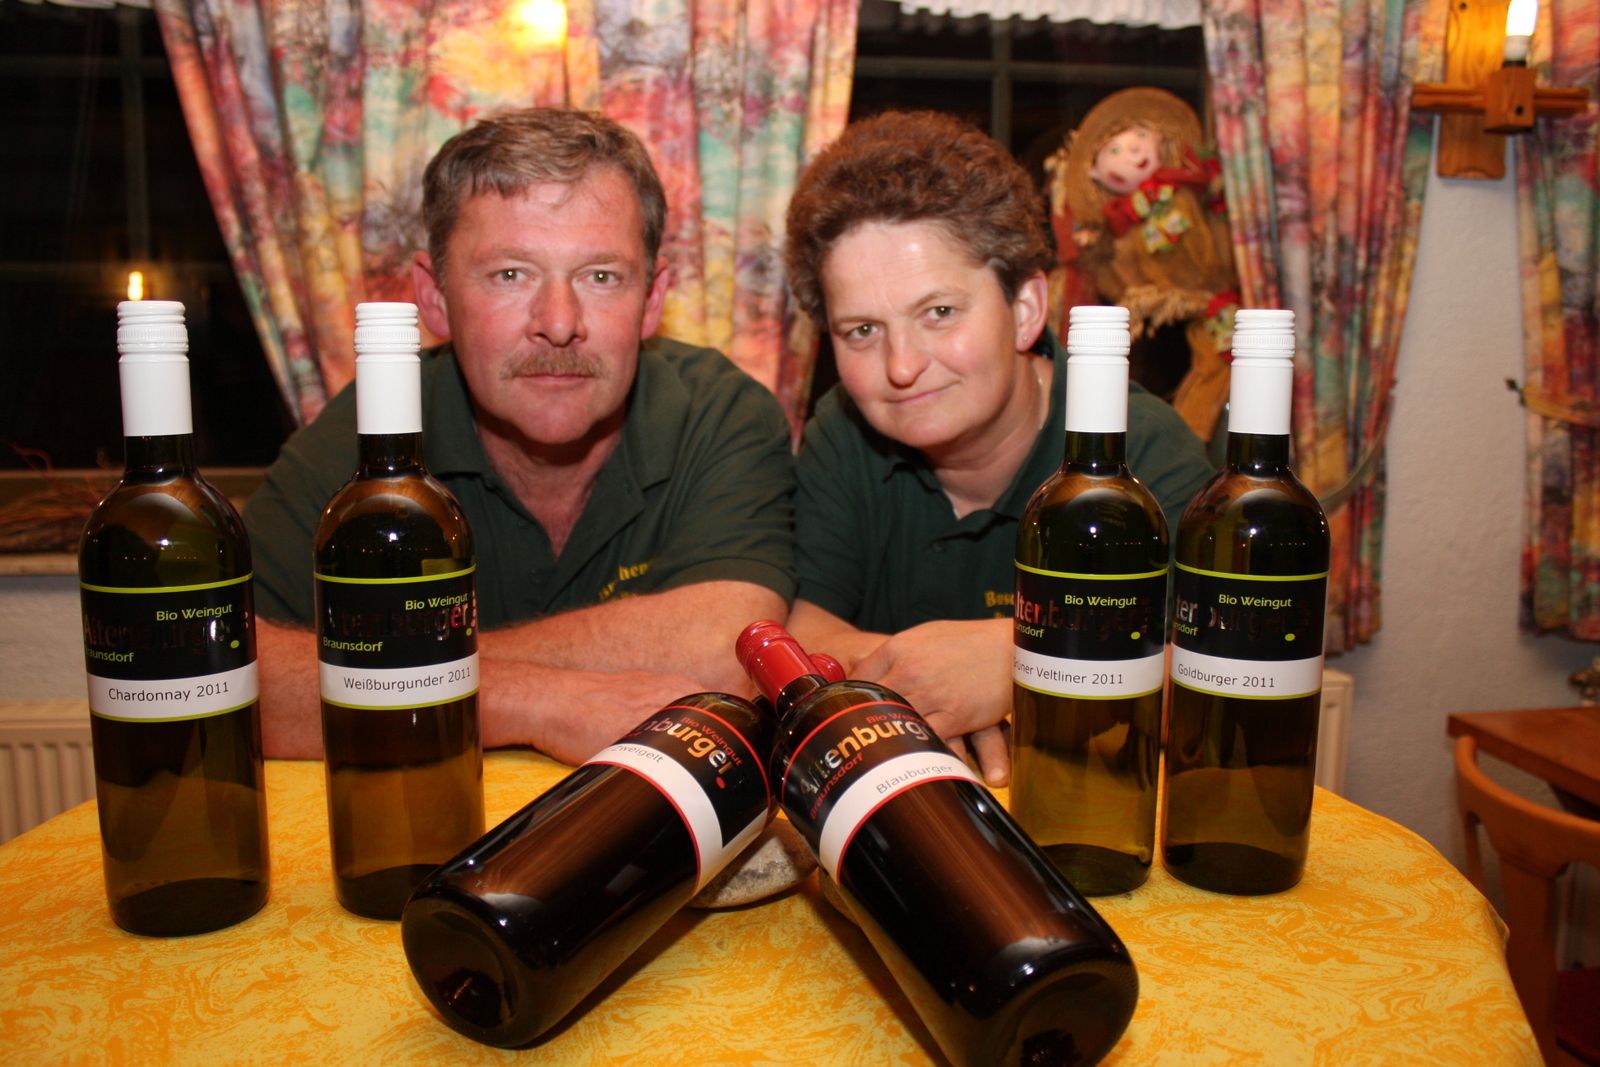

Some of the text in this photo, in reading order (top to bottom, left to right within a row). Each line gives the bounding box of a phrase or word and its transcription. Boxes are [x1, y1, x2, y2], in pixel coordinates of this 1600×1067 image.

[405, 592, 468, 611] Bio Weingut
[1064, 594, 1137, 609] Bio Weingut
[1218, 593, 1293, 610] Bio Weingut
[156, 603, 233, 621] Bio Weingut
[323, 636, 383, 652] Braunsdorf
[343, 666, 471, 692] Weißburgunder 2011
[1036, 666, 1087, 684] Veltliner
[1092, 673, 1124, 685] 2011
[1178, 663, 1275, 688] Goldburger 2011
[108, 681, 229, 702] Chardonnay 2011
[610, 745, 663, 763] Zweigelt
[702, 724, 743, 766] Weingut
[876, 765, 953, 794] Blauburger
